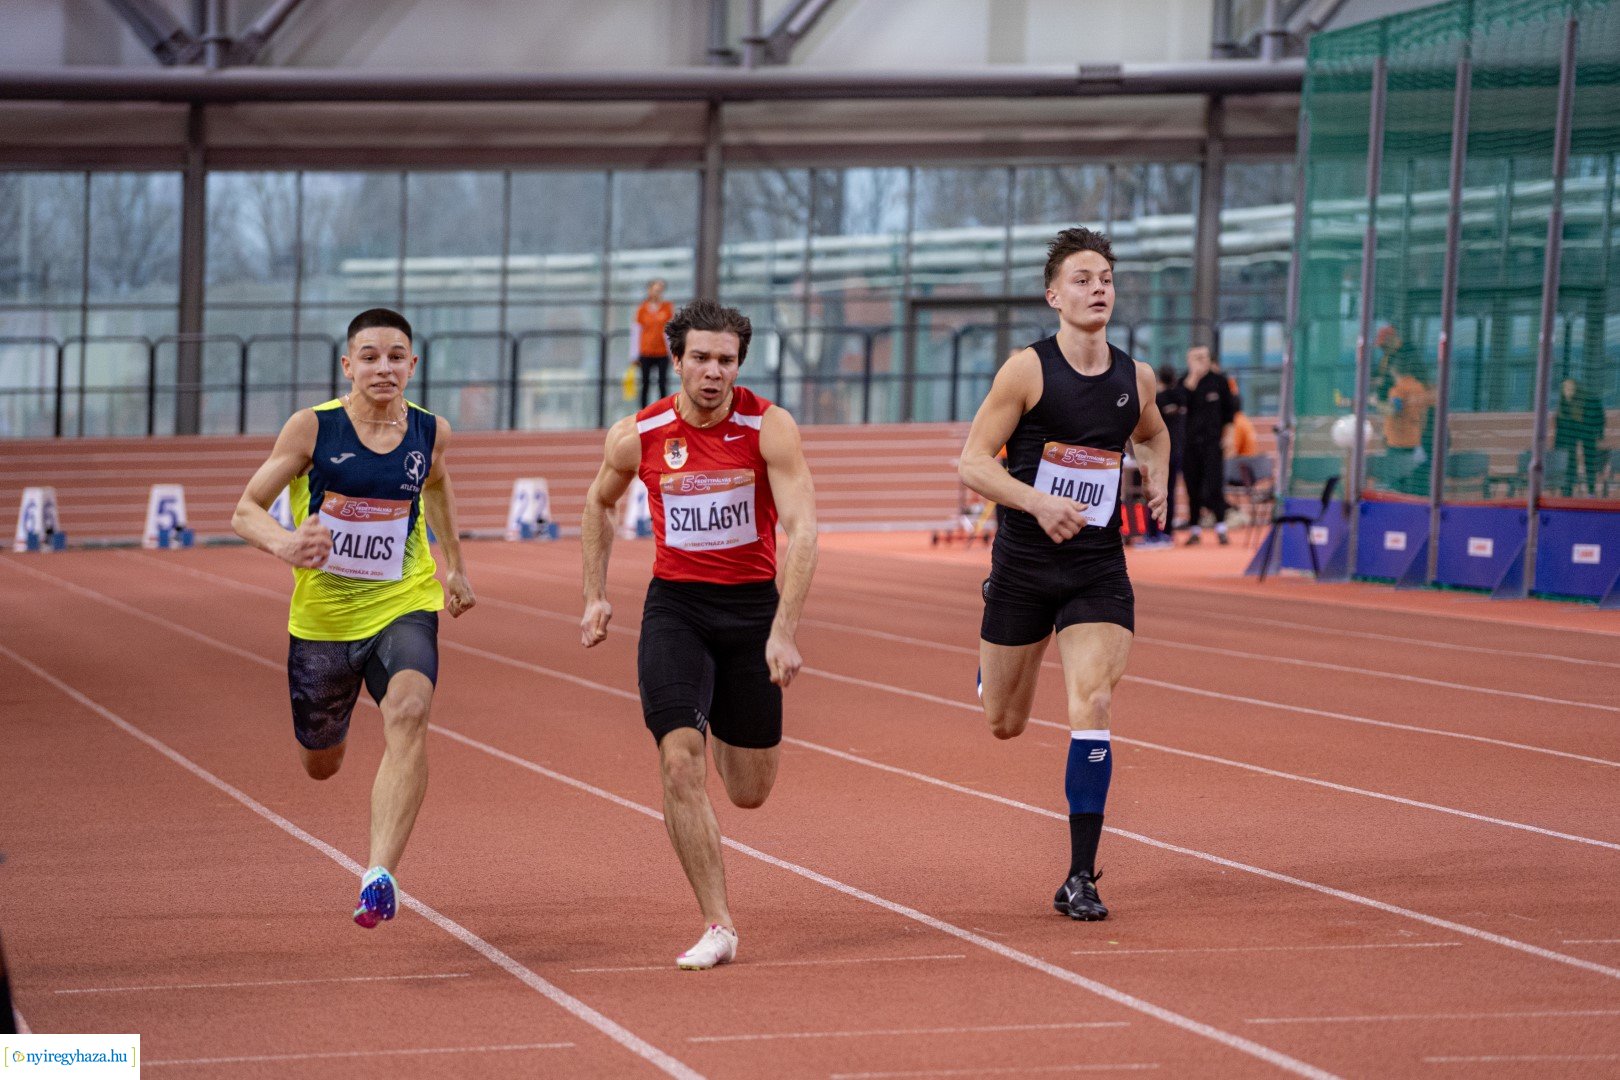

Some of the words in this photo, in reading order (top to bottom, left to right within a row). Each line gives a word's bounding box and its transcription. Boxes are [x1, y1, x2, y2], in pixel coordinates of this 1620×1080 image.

[1050, 476, 1105, 507] HAJDU
[157, 495, 179, 531] 5
[670, 500, 750, 532] SZILÁGYI
[330, 529, 395, 561] KALICS
